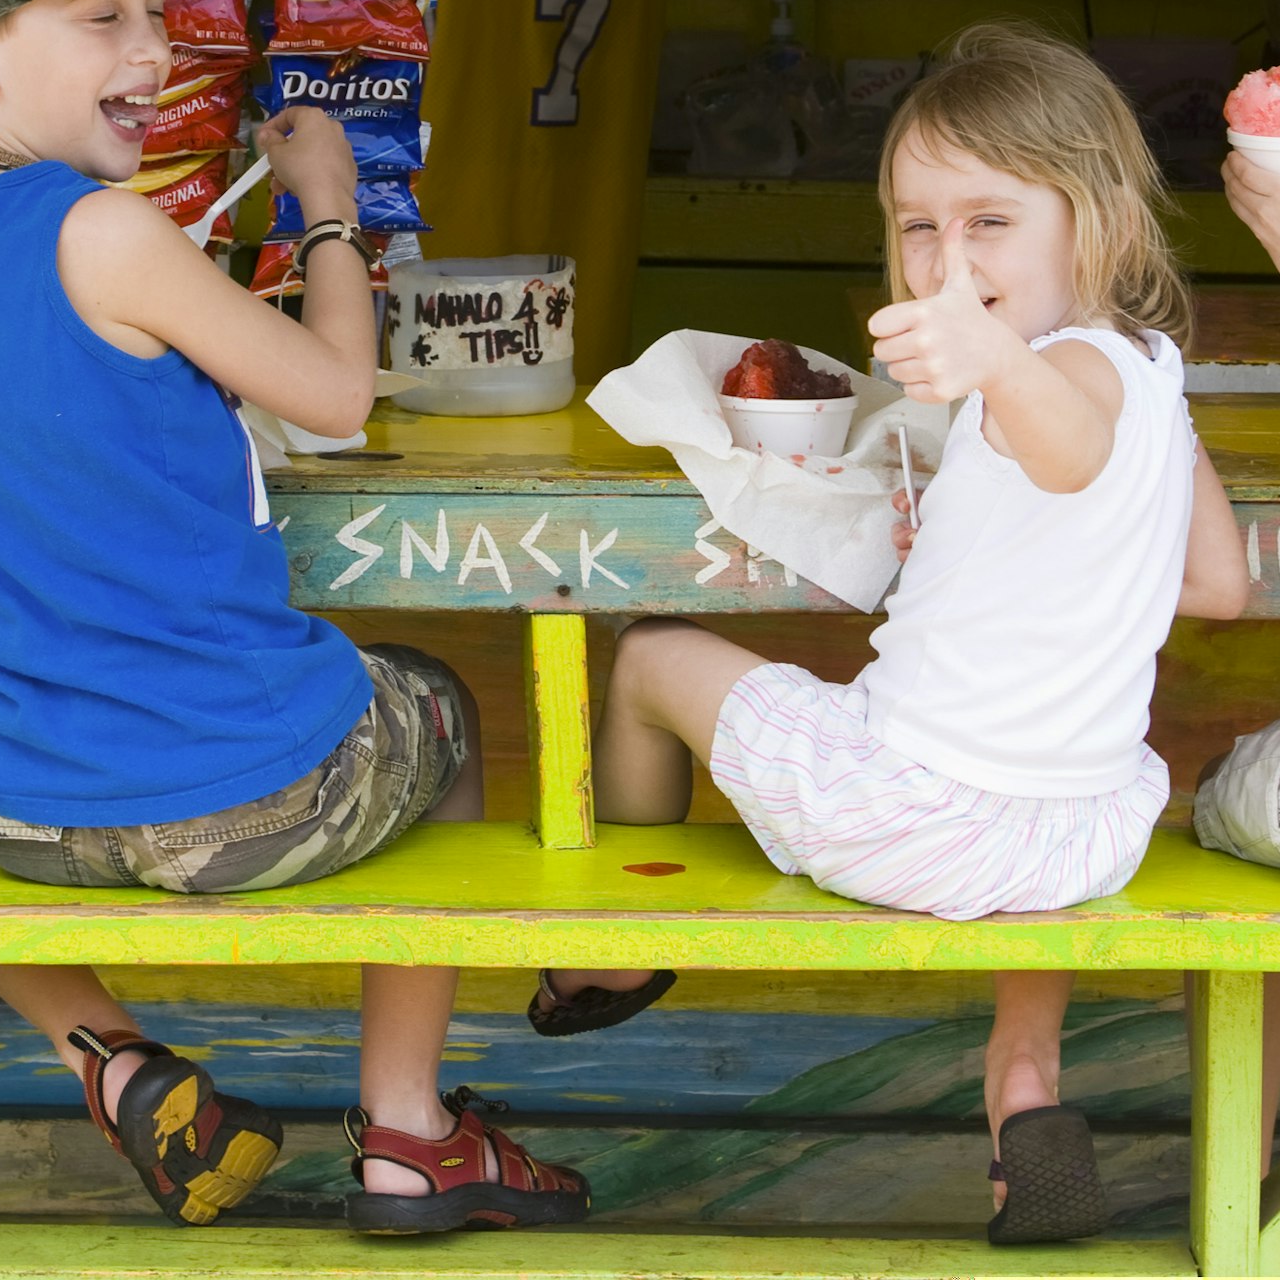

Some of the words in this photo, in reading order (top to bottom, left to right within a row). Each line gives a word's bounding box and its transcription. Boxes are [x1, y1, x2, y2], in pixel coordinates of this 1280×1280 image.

[282, 70, 412, 101] Doritos
[342, 107, 389, 119] Ranch
[414, 291, 503, 329] MAHALO
[510, 290, 541, 324] 4
[328, 503, 631, 595] SNACK
